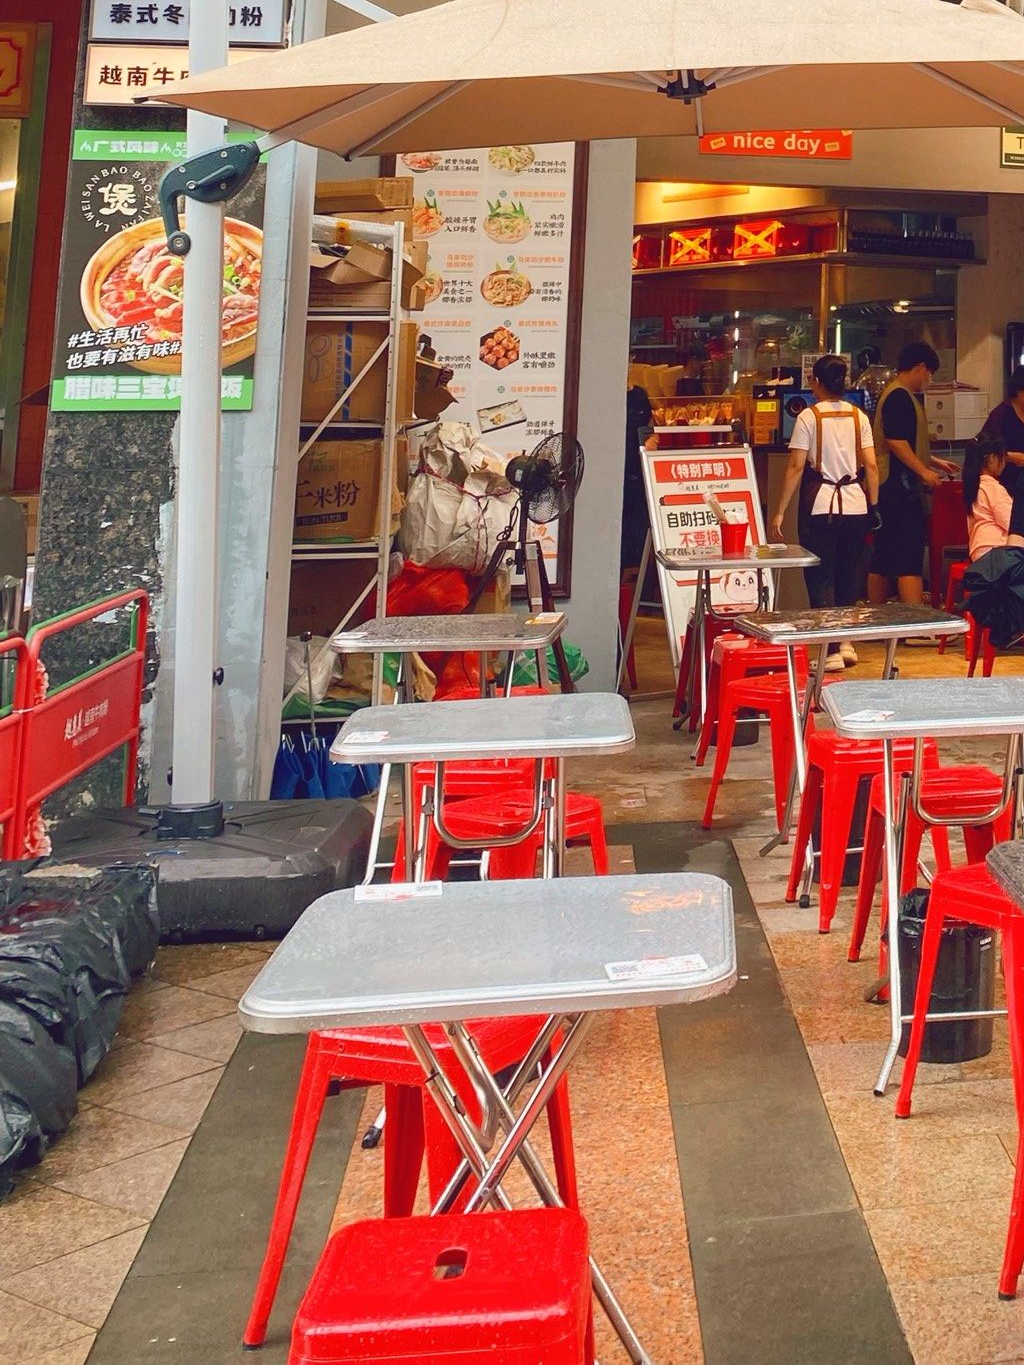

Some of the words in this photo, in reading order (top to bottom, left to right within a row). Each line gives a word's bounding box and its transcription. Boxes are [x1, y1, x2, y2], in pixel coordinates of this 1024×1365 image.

[98, 64, 190, 86] 越南牛
[733, 132, 776, 150] nice
[783, 133, 821, 155] day
